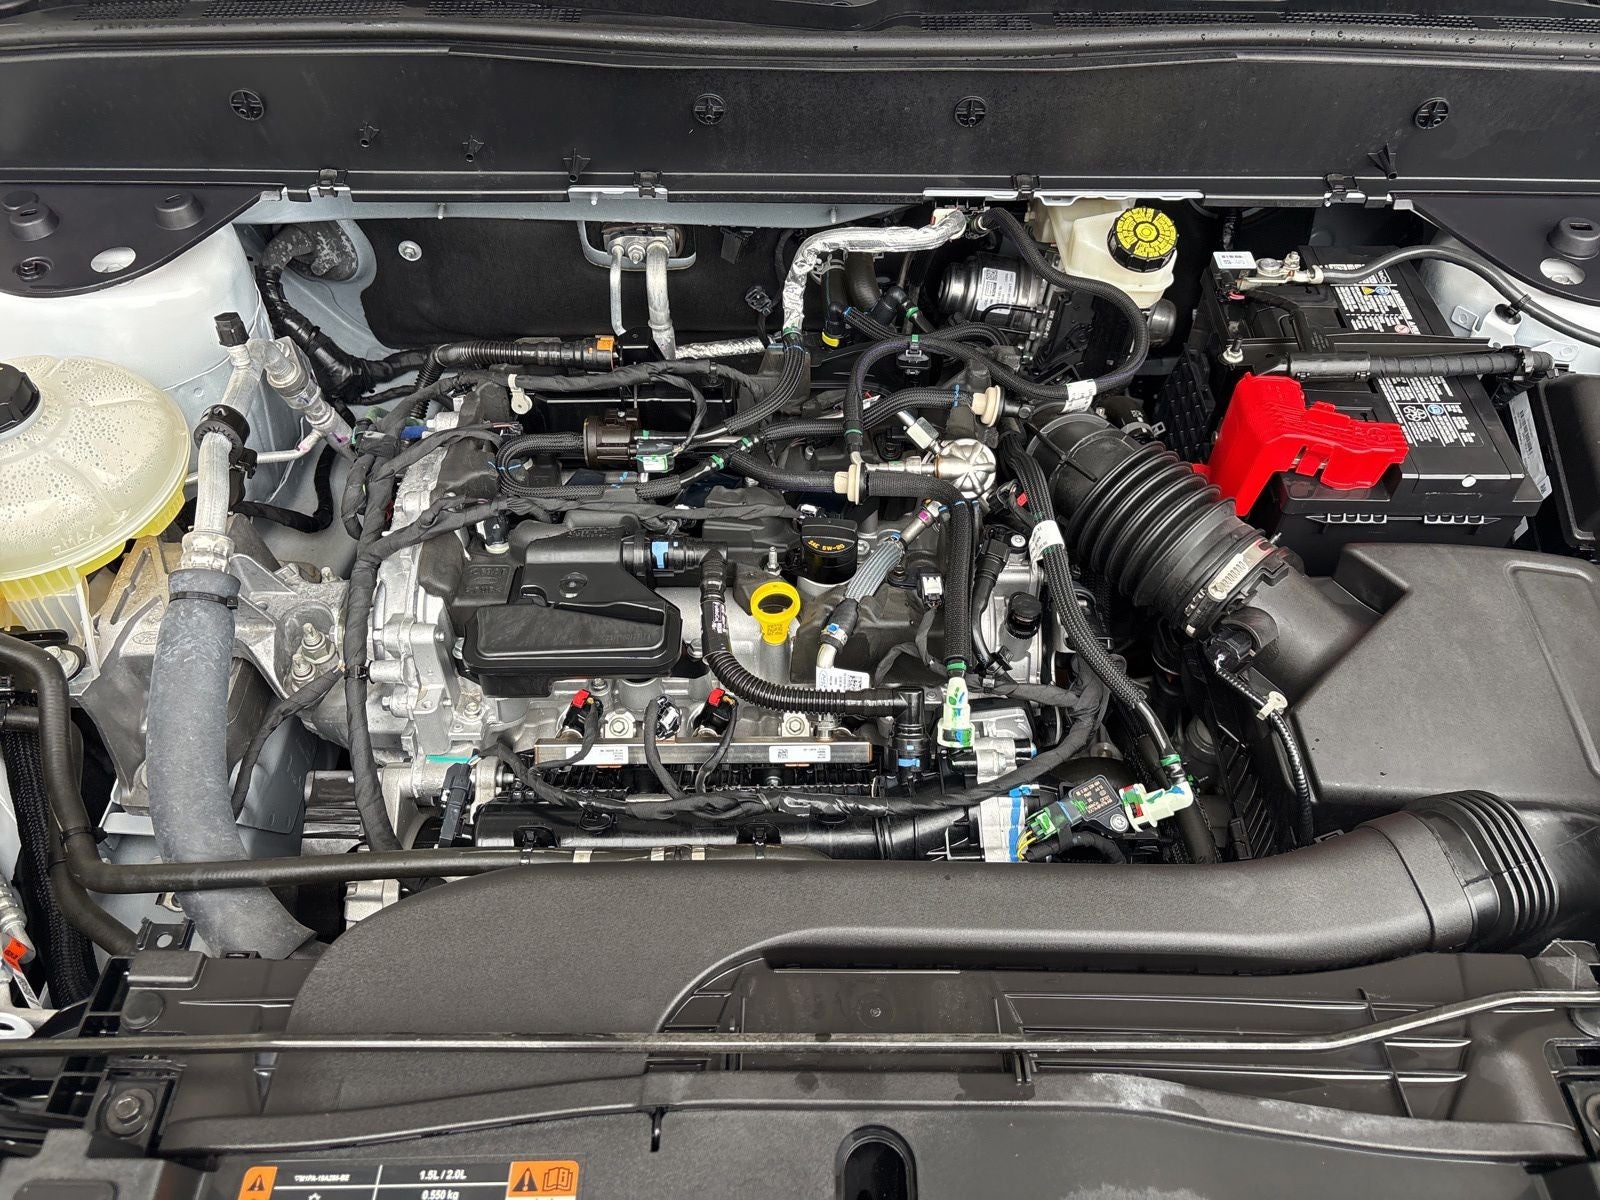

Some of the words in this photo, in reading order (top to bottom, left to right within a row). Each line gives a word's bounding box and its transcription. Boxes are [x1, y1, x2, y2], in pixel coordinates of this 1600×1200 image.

[420, 1169, 440, 1180] 1.5L
[446, 1169, 467, 1180] 2.0L
[421, 1189, 447, 1200] 0.550
